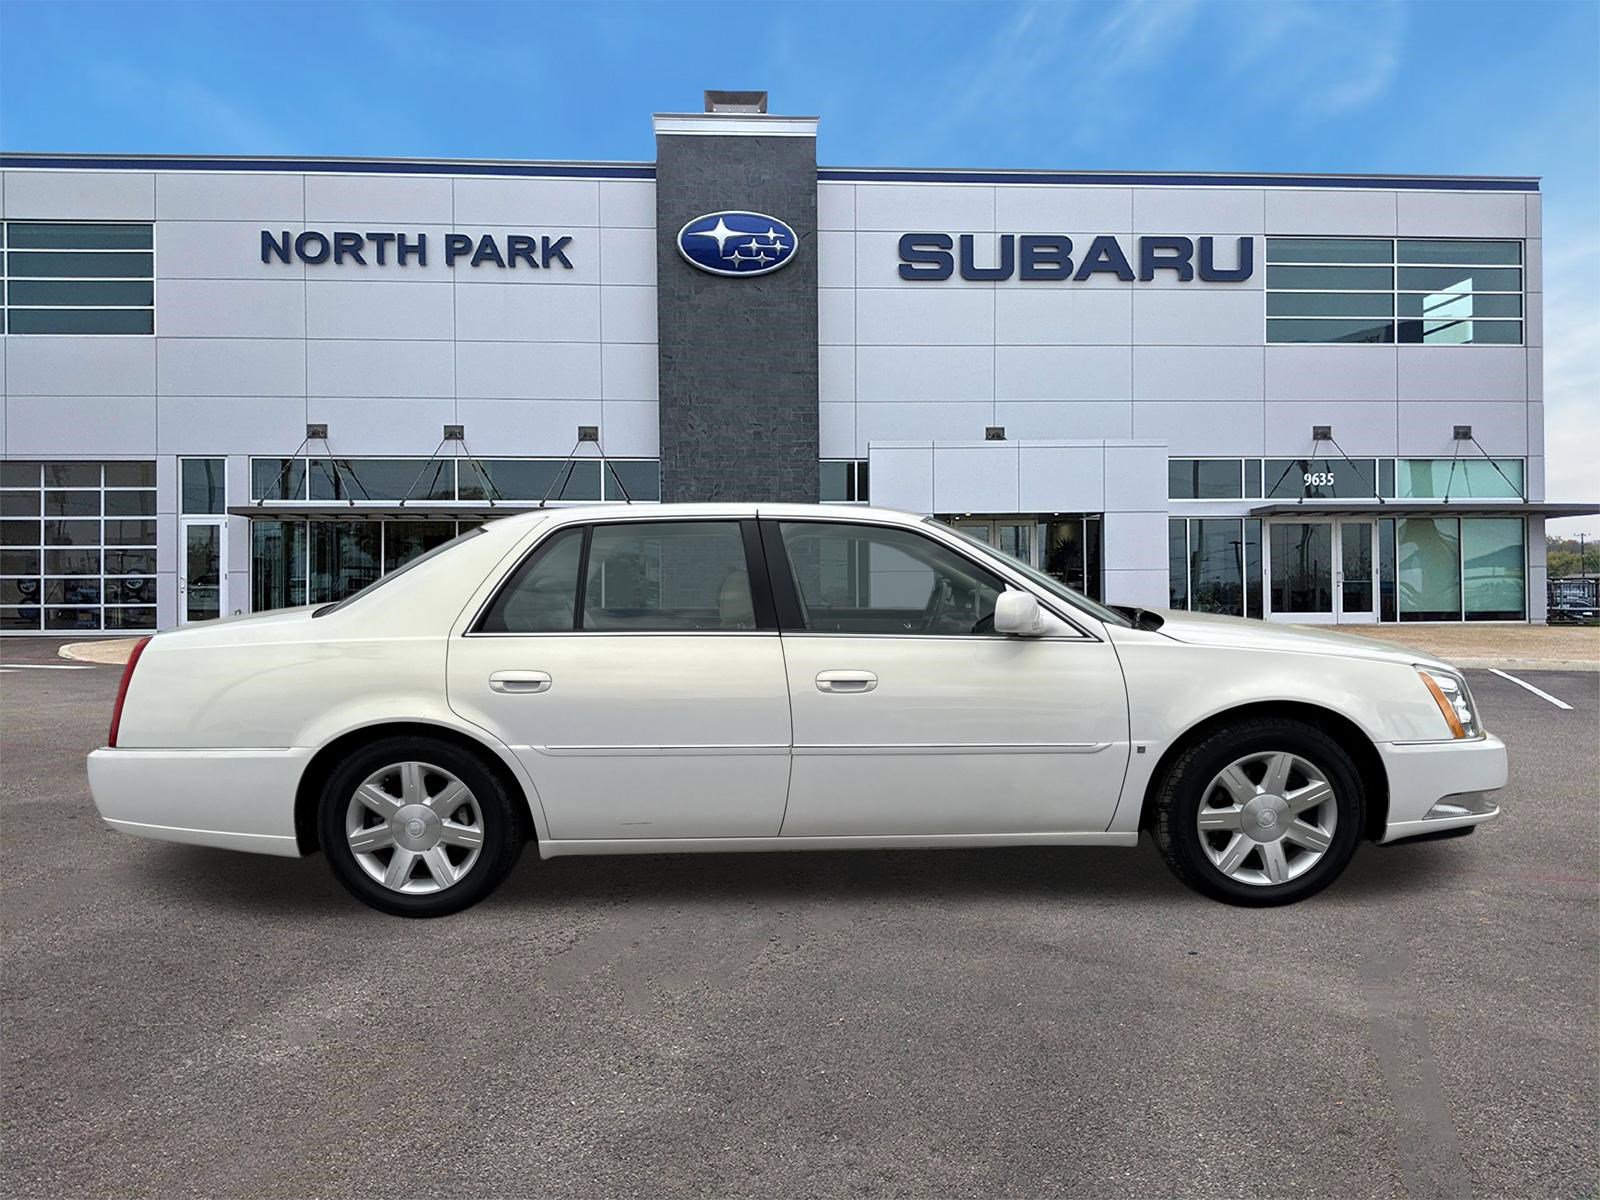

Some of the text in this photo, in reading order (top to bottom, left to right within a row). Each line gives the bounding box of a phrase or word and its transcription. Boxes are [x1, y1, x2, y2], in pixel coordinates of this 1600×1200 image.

[261, 230, 574, 269] NORTH PARK
[898, 233, 1253, 283] SUBARU
[1303, 472, 1335, 487] 9635
